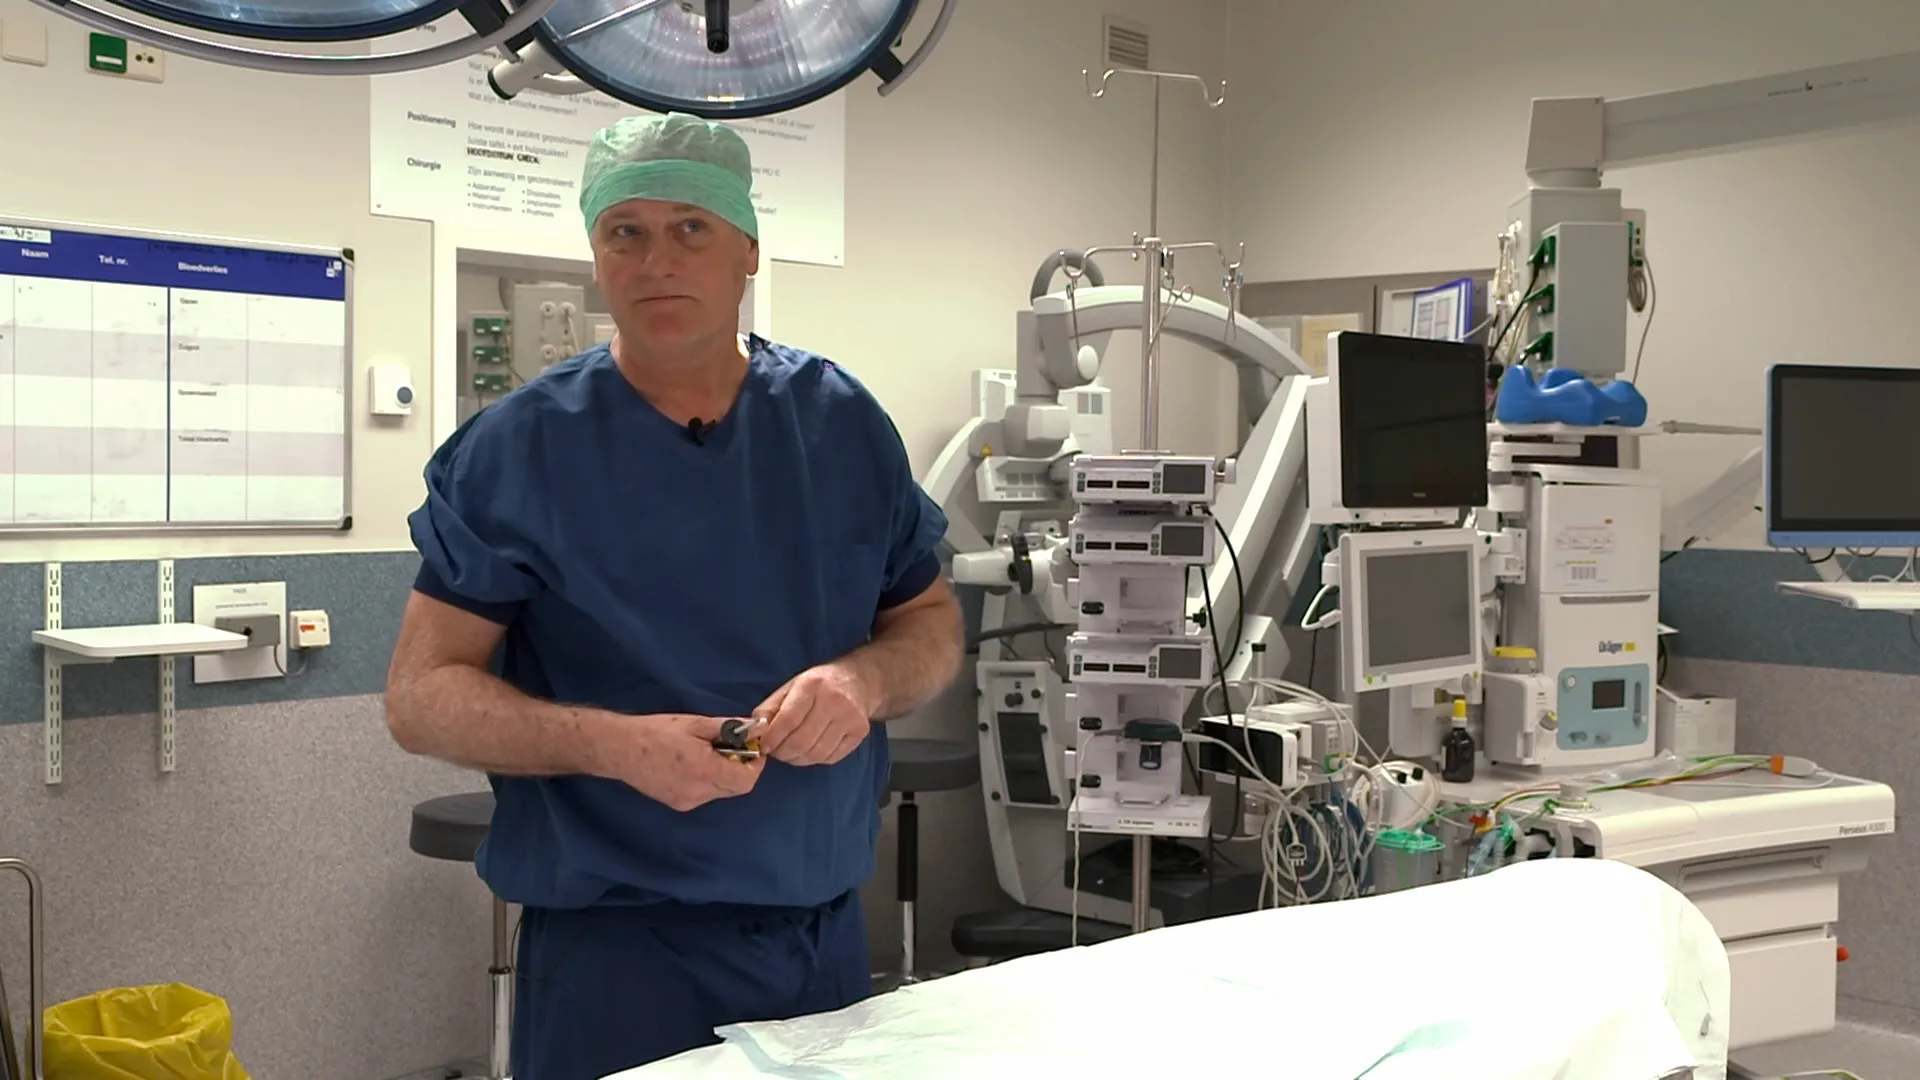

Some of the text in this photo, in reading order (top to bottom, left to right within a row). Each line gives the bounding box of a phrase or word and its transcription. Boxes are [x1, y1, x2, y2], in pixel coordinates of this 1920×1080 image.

[407, 110, 456, 129] Positionering
[484, 124, 504, 135] wordt
[407, 157, 441, 171] Chirurgie
[21, 247, 49, 259] Naam
[98, 254, 128, 266] Tel. nr.
[178, 261, 228, 274] Bloedverlies
